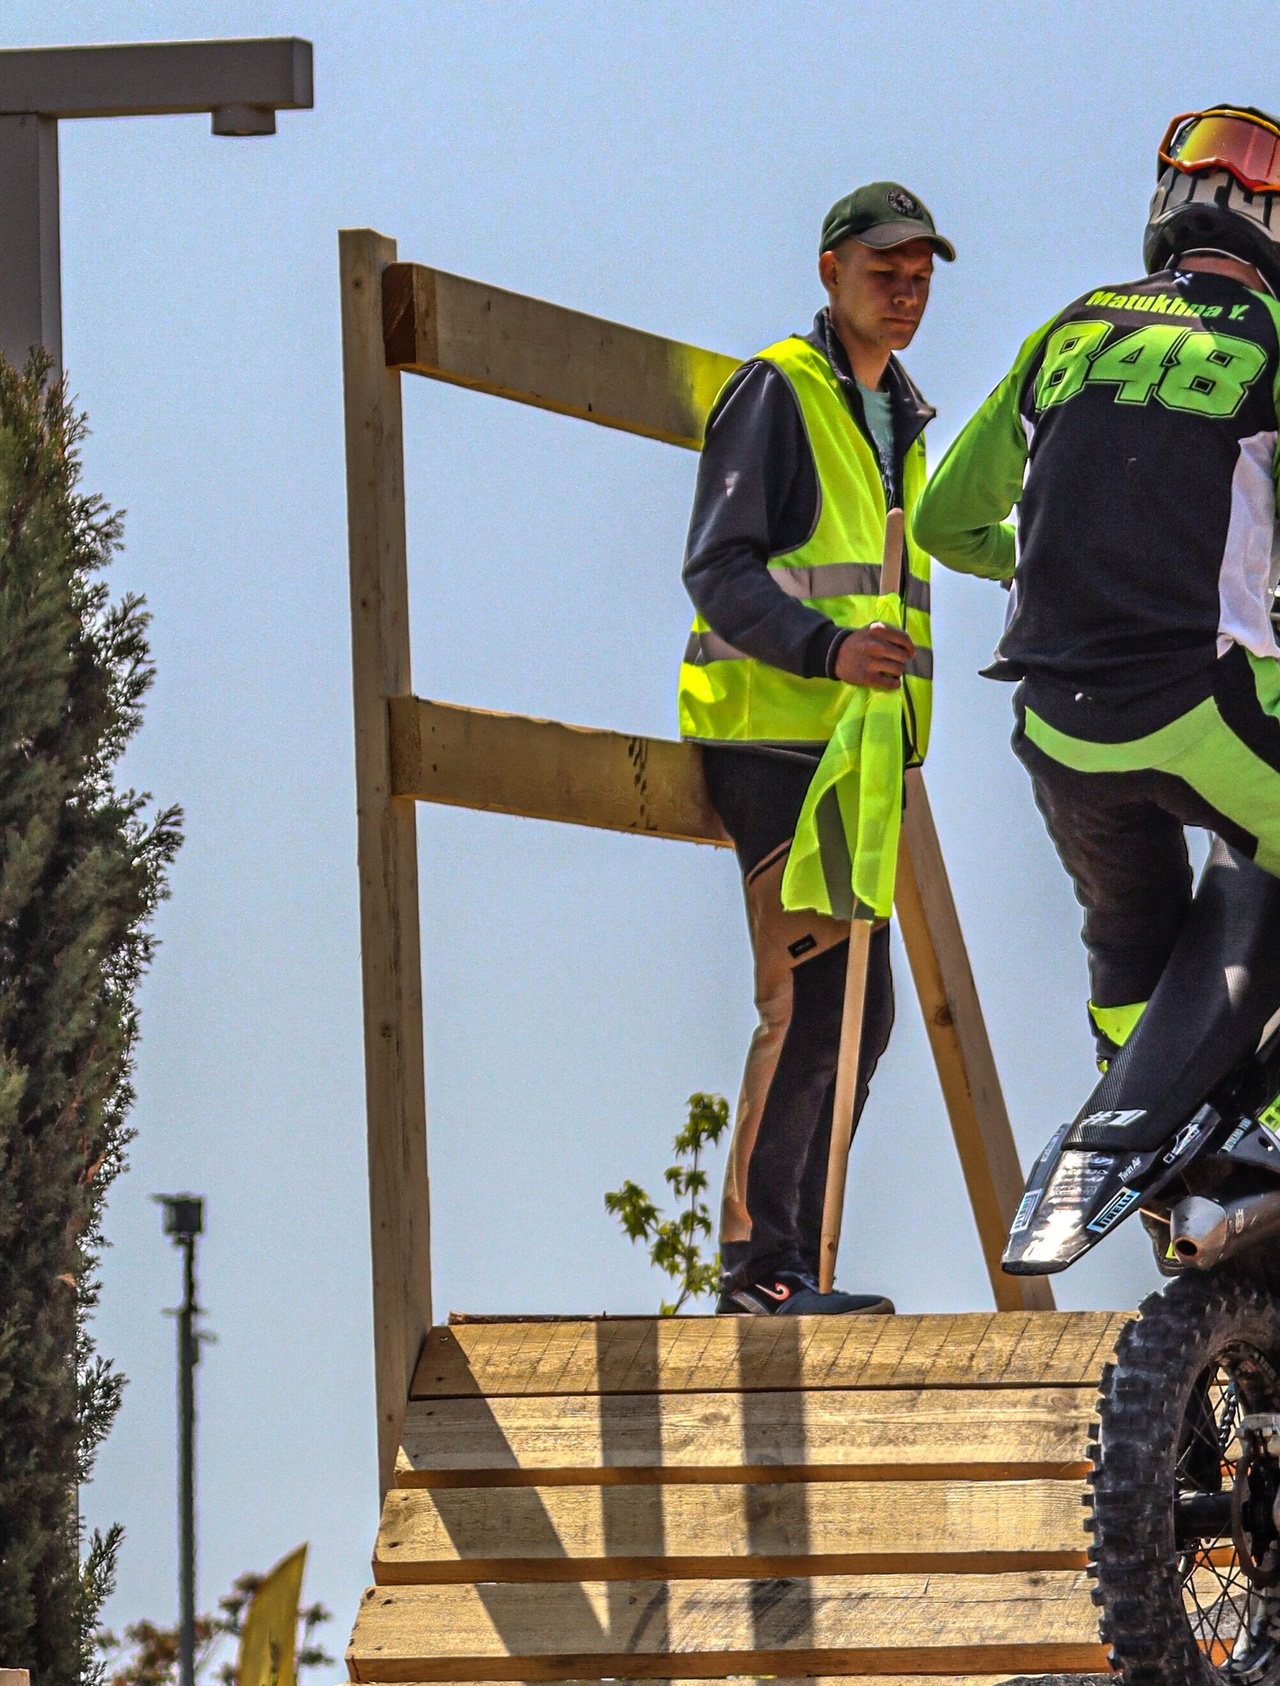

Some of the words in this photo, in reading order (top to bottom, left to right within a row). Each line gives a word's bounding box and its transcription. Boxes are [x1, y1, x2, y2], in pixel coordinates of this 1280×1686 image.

[1227, 303, 1250, 321] Y.
[1034, 318, 1268, 418] 848
[1117, 1164, 1135, 1183] Twin
[1131, 1155, 1142, 1172] Air
[1093, 1189, 1136, 1230] PIRELLI
